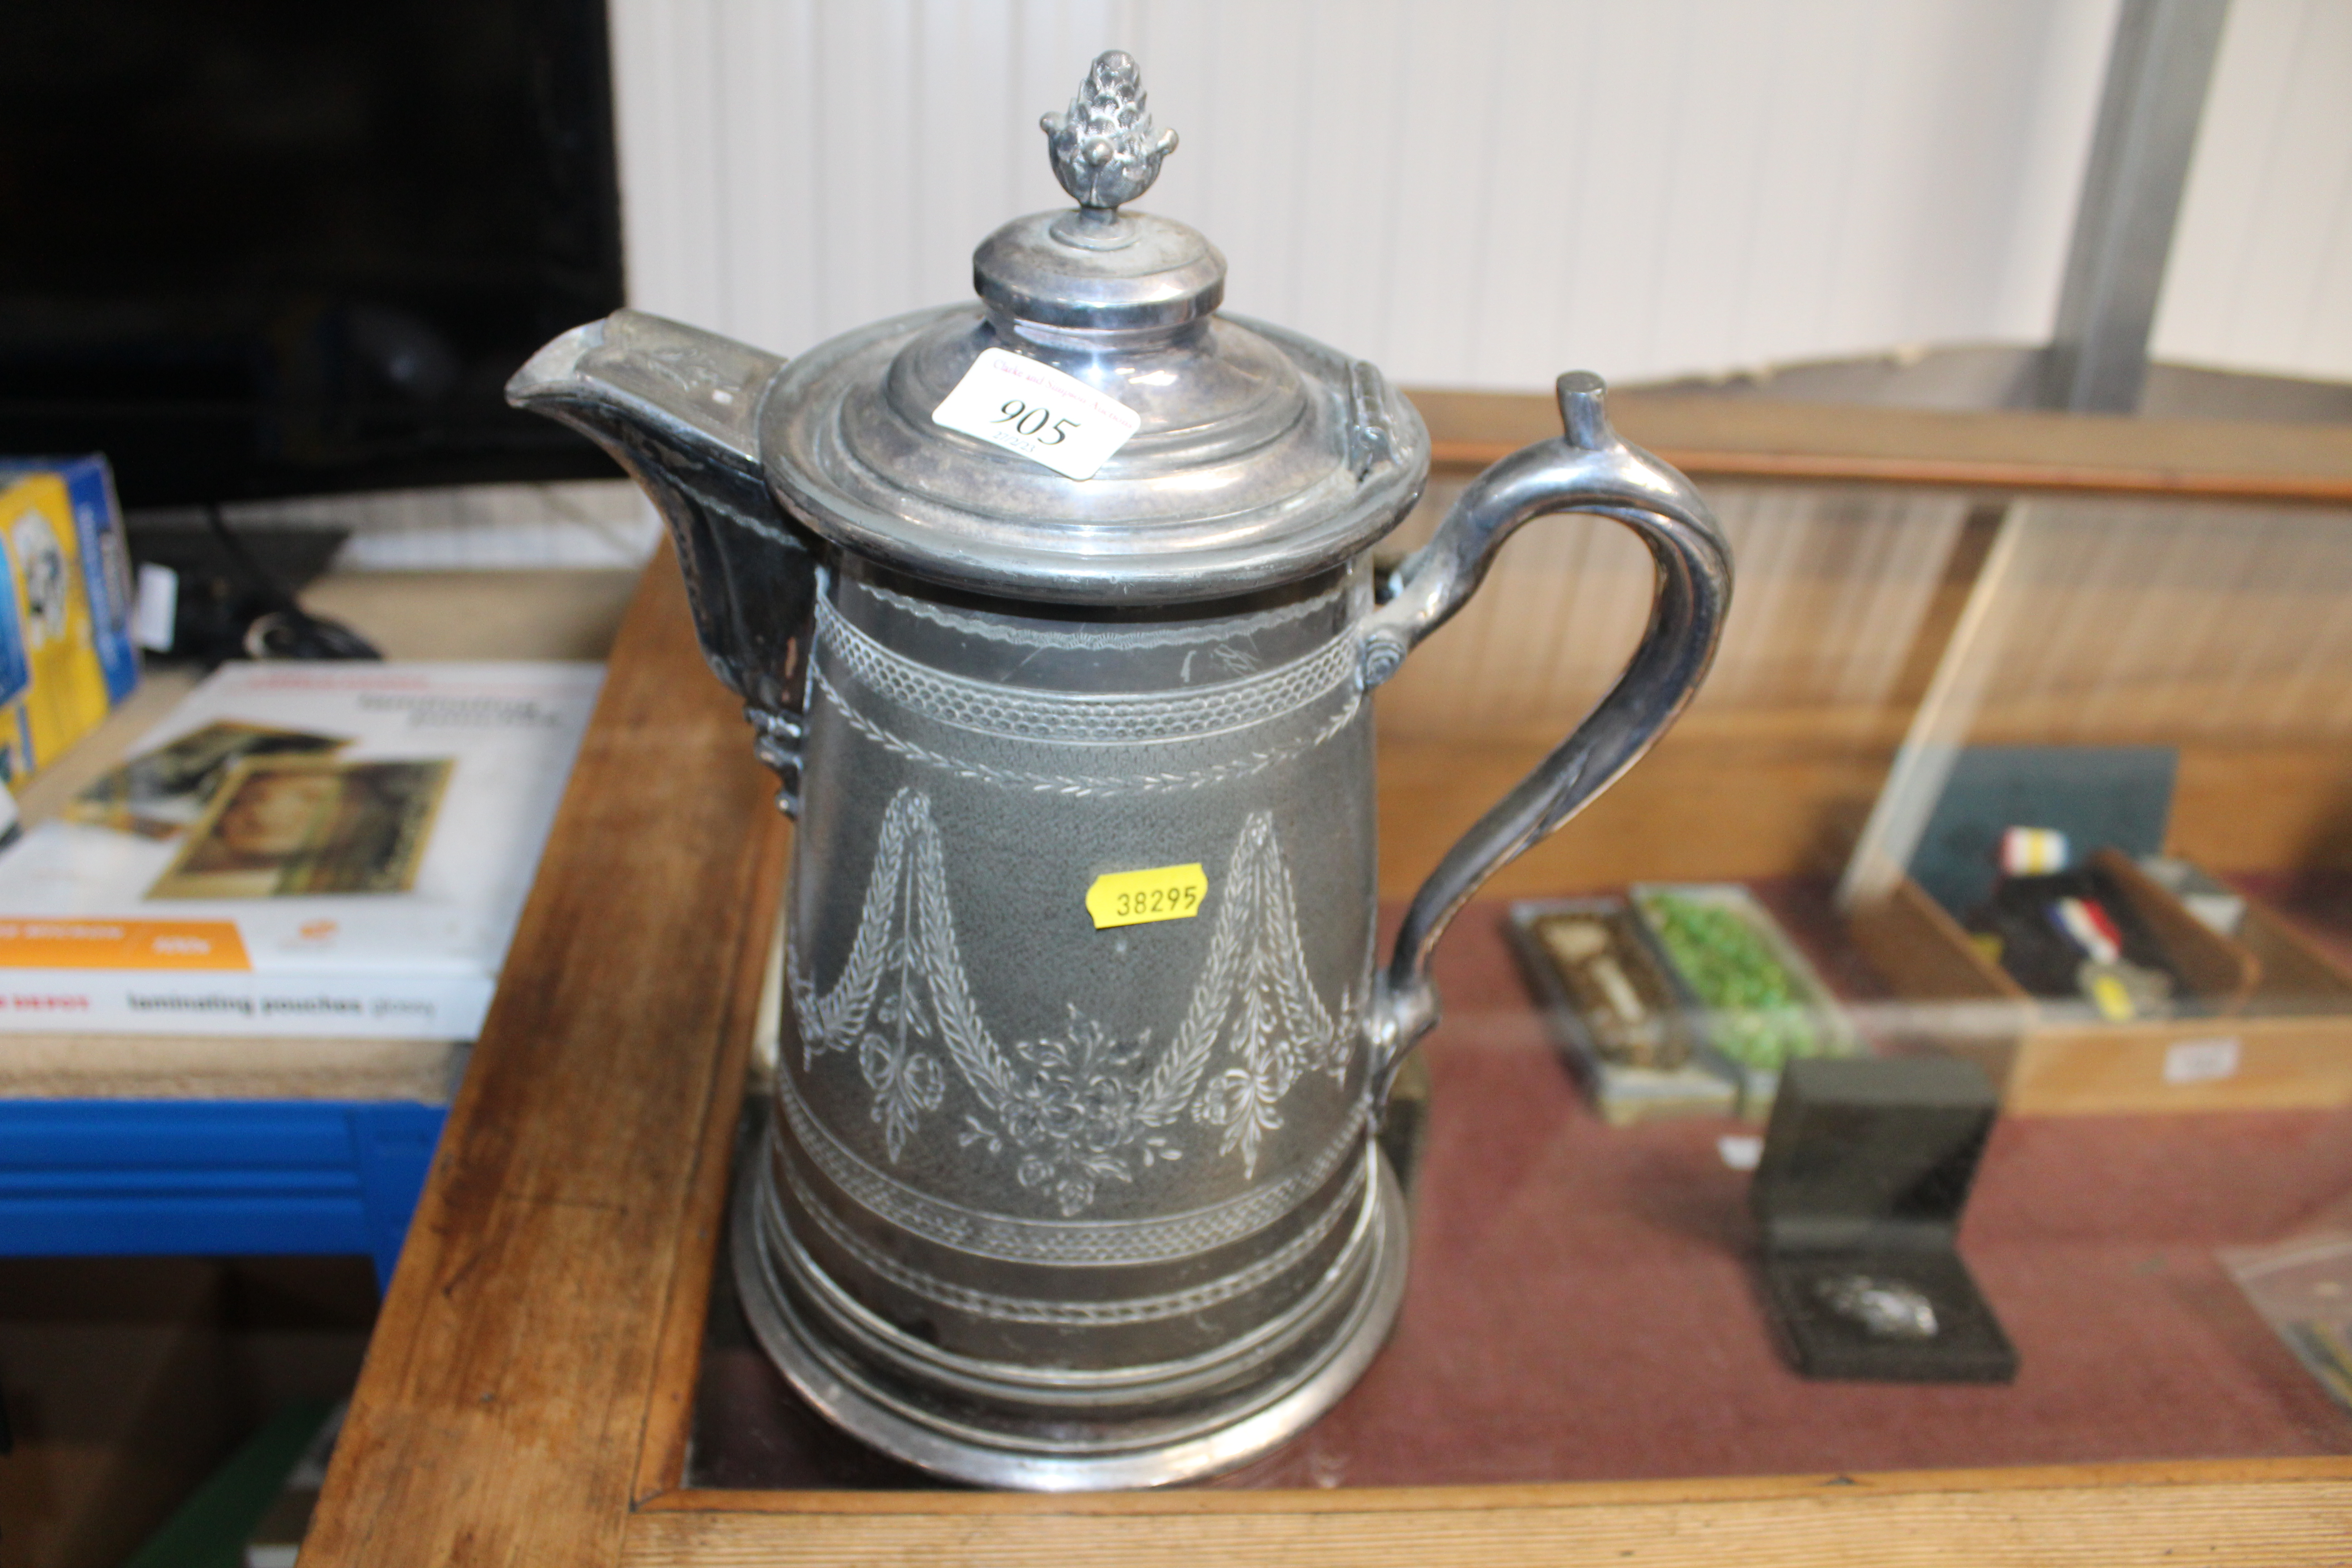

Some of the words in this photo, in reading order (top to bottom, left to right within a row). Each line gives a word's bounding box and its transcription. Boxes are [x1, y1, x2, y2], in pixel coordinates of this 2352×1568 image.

[994, 359, 1023, 377] Clarke
[1026, 375, 1044, 385] and
[1046, 379, 1086, 403] Simpson
[1090, 402, 1132, 428] Auctions
[989, 400, 1081, 445] 905
[1117, 886, 1197, 916] 38295
[127, 990, 253, 1015] laminating
